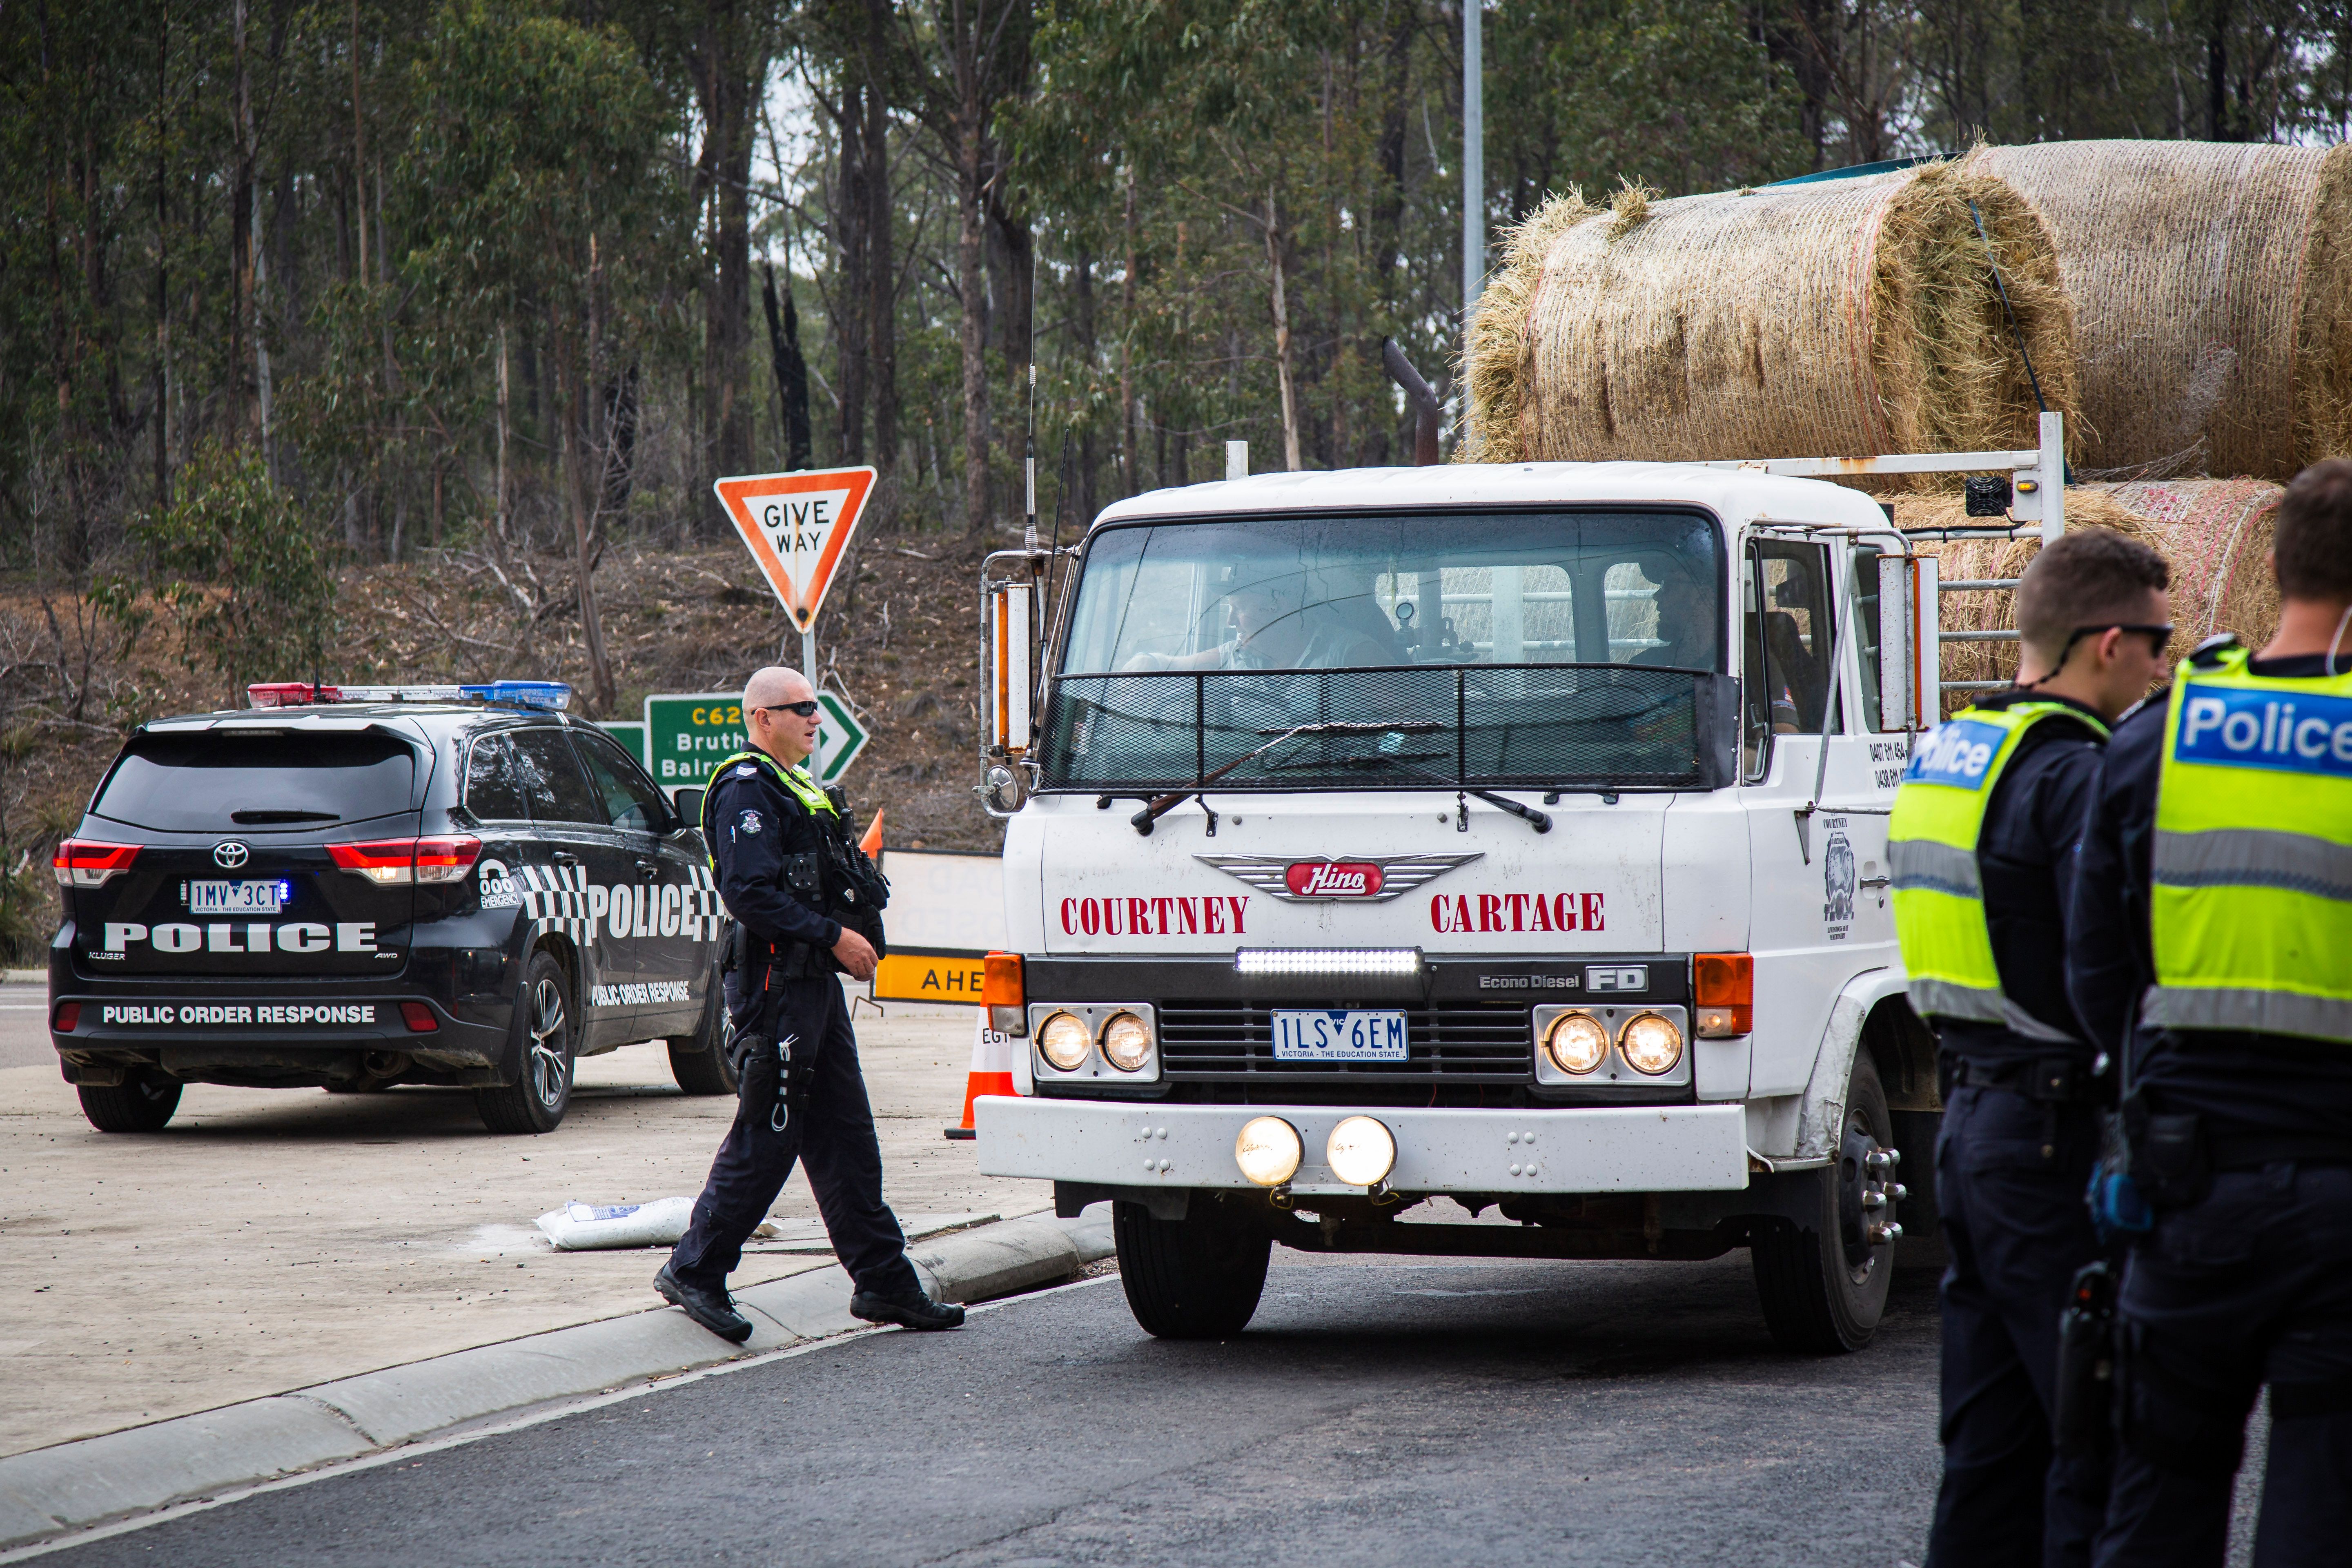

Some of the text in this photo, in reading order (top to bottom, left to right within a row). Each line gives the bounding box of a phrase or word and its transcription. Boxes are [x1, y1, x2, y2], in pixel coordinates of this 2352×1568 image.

[764, 500, 829, 528] GIVE
[776, 531, 821, 553] WAY
[692, 706, 741, 725] C62
[2183, 697, 2352, 763] Police
[676, 732, 745, 751] Bruth
[1869, 742, 1906, 762] 0407 611 454
[1875, 766, 1891, 788] 0438
[1823, 817, 1847, 829] COURTNEY
[480, 878, 514, 895] 000
[1302, 864, 1366, 894] Hino
[196, 885, 278, 906] 1MV 3CT
[481, 894, 519, 907] EMERGENCY
[587, 884, 694, 938] POLICE
[1061, 893, 1605, 935] COURTNEY CARTAGE
[105, 922, 377, 952] POLICE
[89, 952, 125, 960] KLUGER
[921, 969, 985, 992] AHE
[1479, 976, 1579, 988] Econo Diesel
[1588, 969, 1646, 990] FD
[592, 980, 689, 1007] PUBLIC ORDER RESPONSE
[103, 1006, 375, 1023] PUBLIC ORDER RESPONSE
[1281, 1018, 1403, 1049] 1LS 6EM
